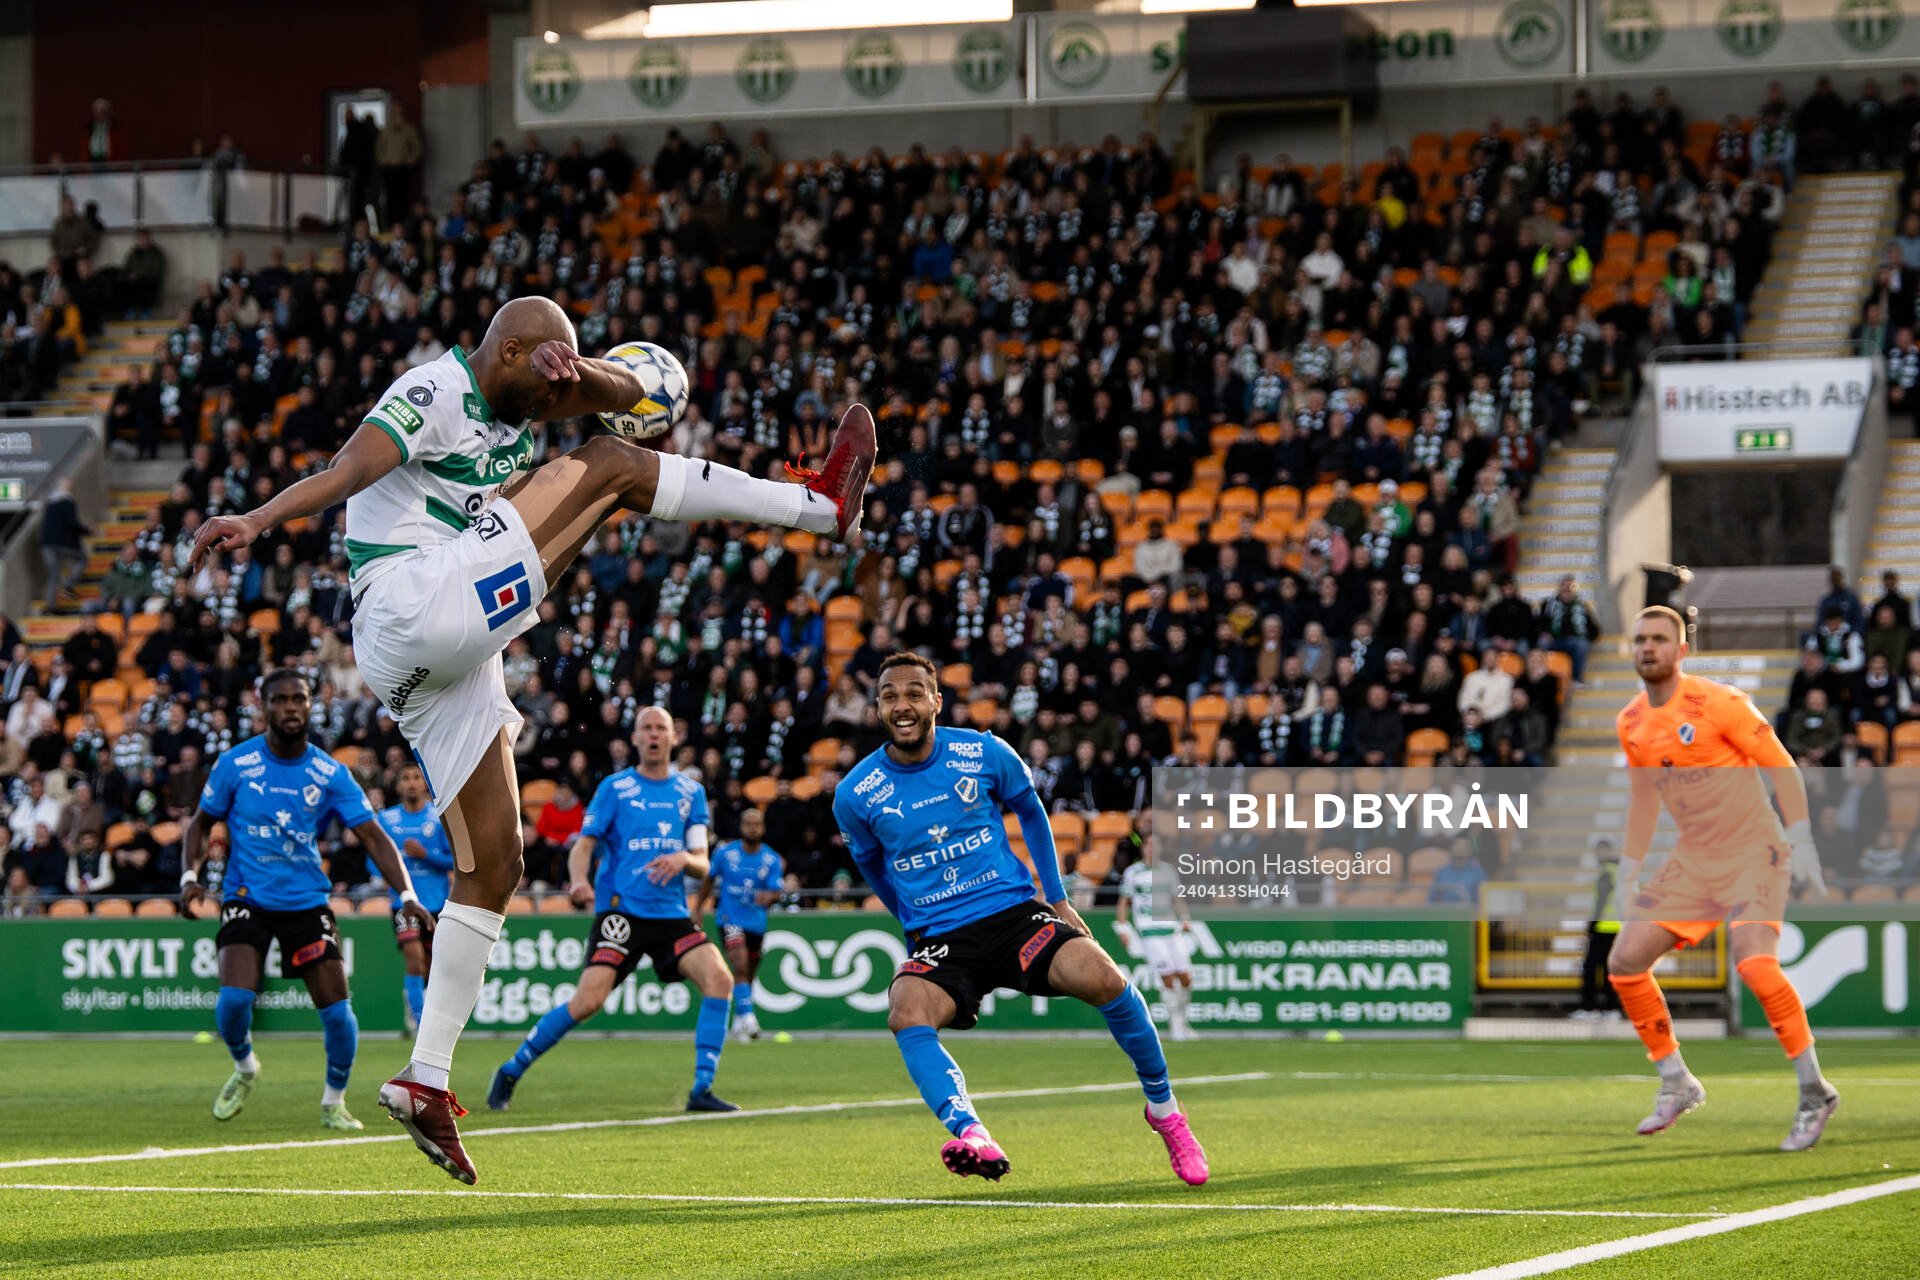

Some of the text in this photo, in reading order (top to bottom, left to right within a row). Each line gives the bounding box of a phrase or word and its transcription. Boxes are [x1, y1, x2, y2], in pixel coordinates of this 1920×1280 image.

[1683, 380, 1865, 411] Hisstech AB
[948, 741, 984, 753] sport
[893, 826, 993, 872] GETINGE
[61, 937, 185, 980] SKYLT
[1225, 938, 1449, 960] VIGO ANDERSSON
[1117, 962, 1451, 992] MBILKRANAR
[61, 985, 219, 1015] skyltar bildeko
